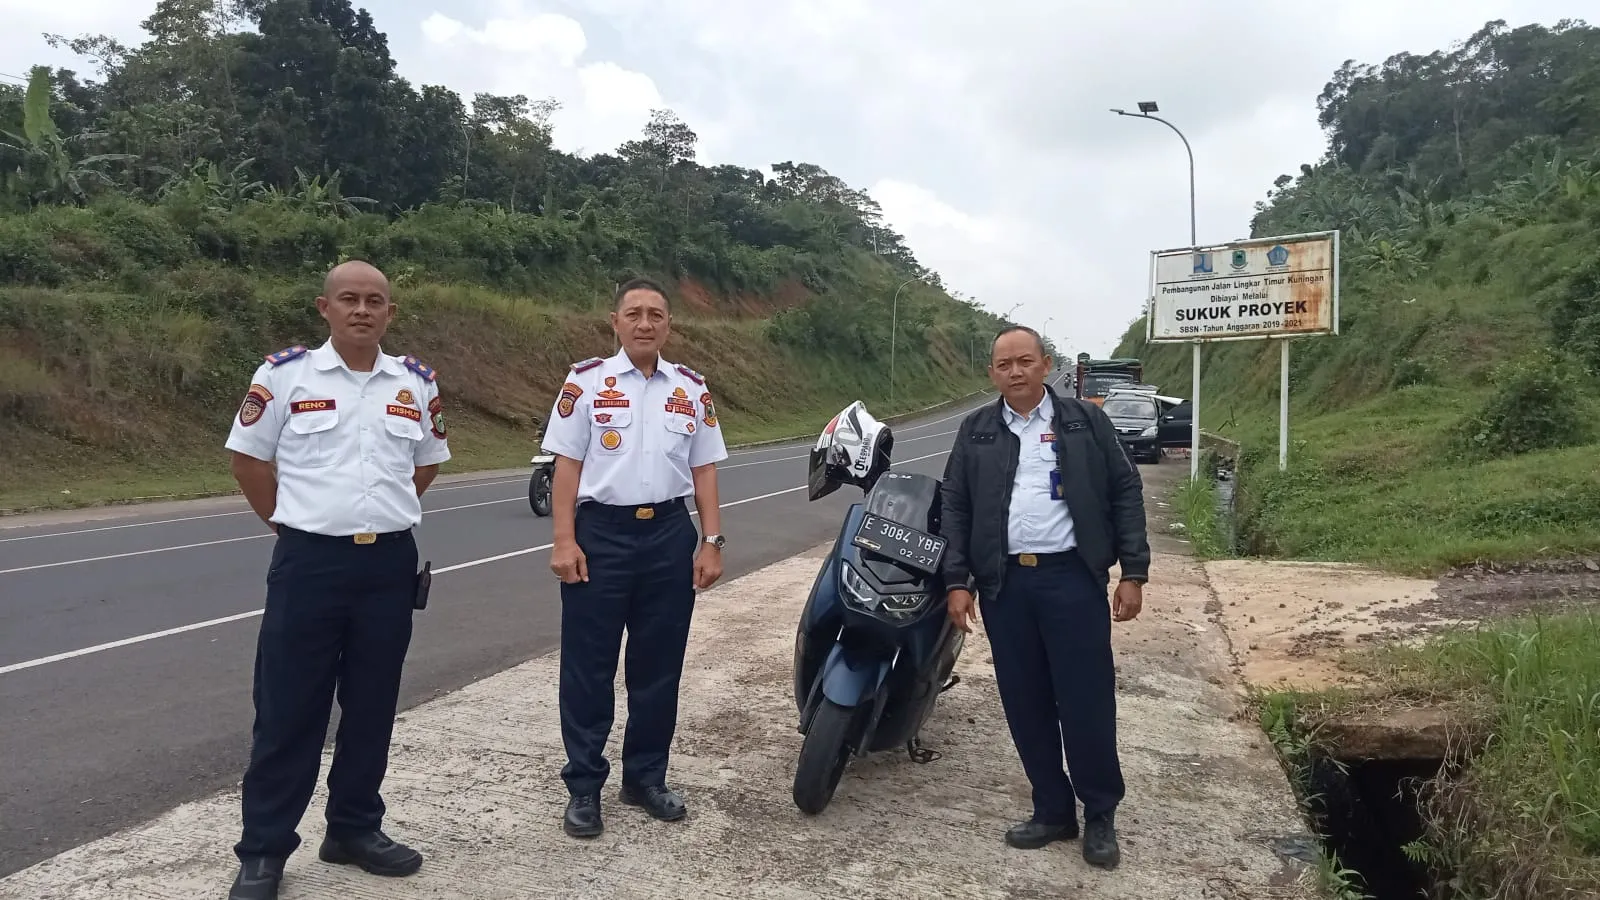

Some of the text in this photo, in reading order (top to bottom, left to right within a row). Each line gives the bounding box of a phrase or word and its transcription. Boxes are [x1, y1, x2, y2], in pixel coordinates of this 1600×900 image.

[1162, 284, 1210, 294] Pembangunan
[1234, 280, 1261, 290] Lingkar
[1264, 277, 1285, 286] Timur
[1288, 274, 1324, 284] Kuningan
[1210, 291, 1268, 303] Dibiayai Melalui
[1175, 300, 1308, 321] SUKUK PROYEK
[1226, 322, 1260, 331] Anggaran
[298, 401, 326, 410] RENO
[865, 518, 942, 553] E 3084 YBF
